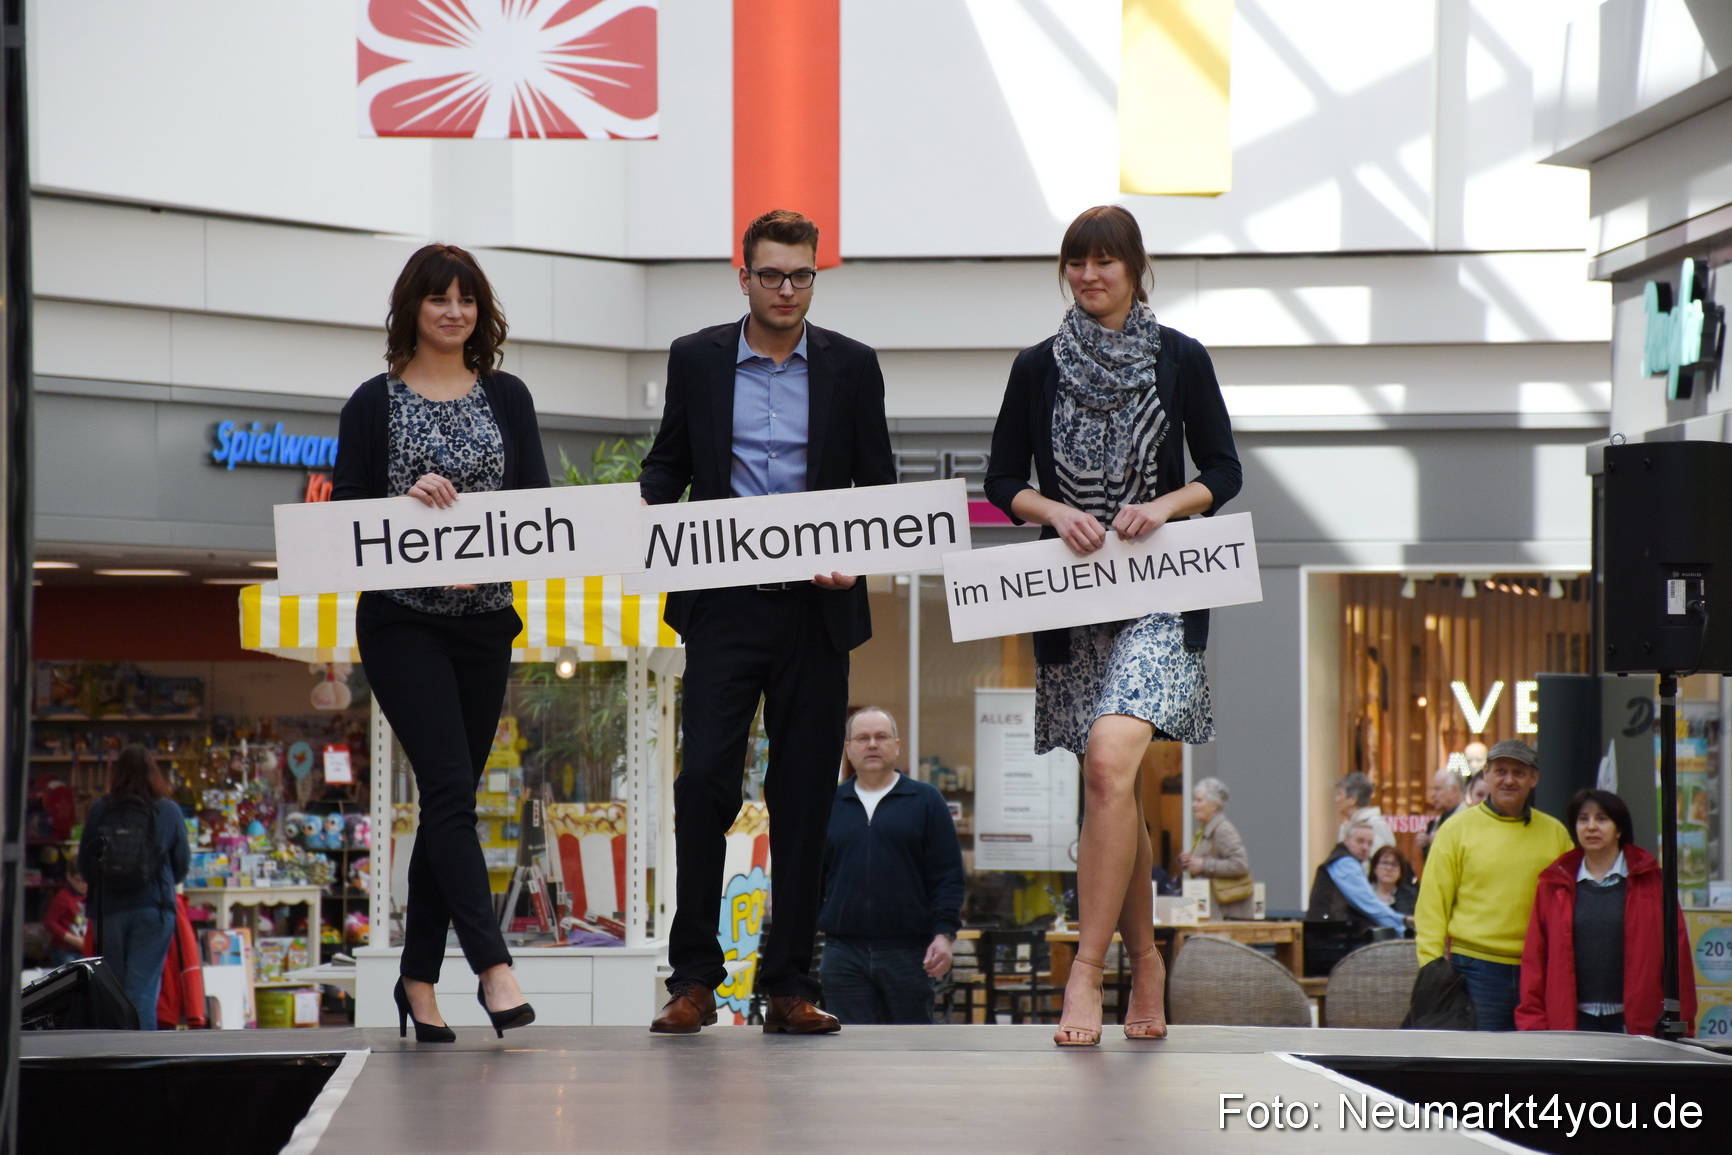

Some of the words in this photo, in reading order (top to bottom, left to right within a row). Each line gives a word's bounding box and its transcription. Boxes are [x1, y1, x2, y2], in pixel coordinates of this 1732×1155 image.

[353, 507, 576, 567] Herzlich
[645, 510, 957, 569] Willkommen
[953, 580, 989, 606] im
[1000, 559, 1118, 601] NEUEN
[1128, 542, 1246, 584] MARKT
[980, 713, 1023, 725] ALLES
[1700, 1019, 1732, 1035] -20
